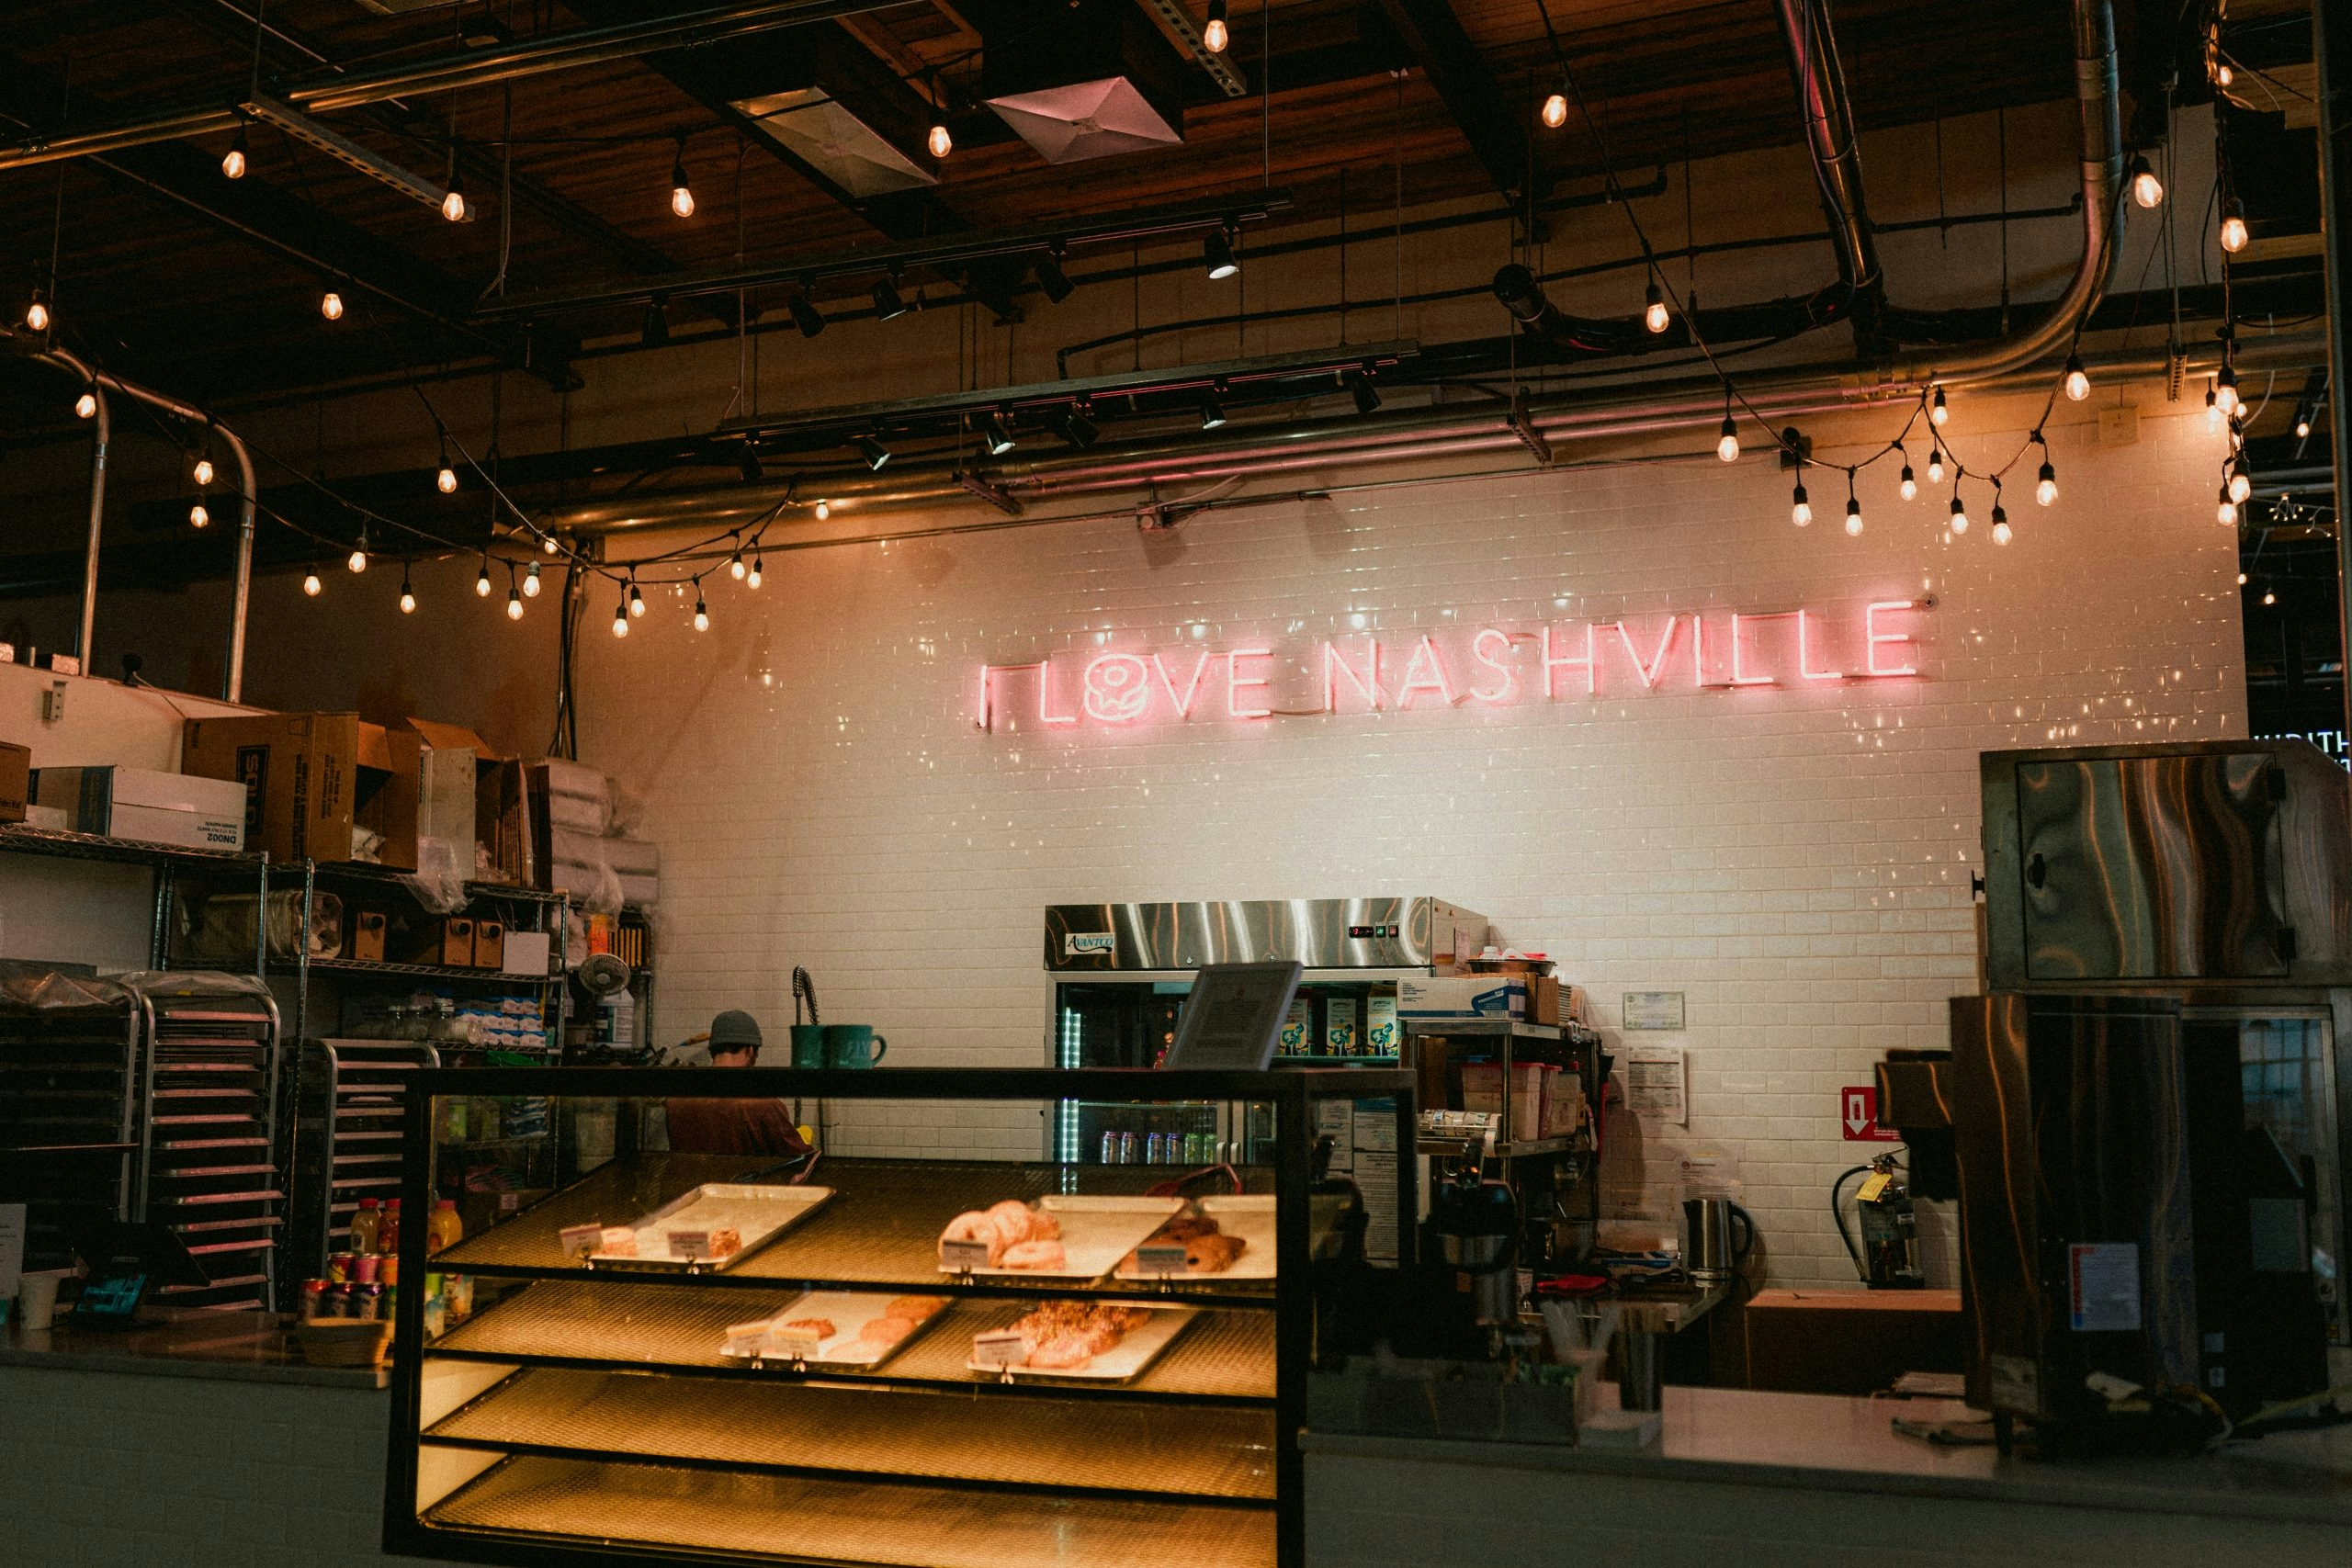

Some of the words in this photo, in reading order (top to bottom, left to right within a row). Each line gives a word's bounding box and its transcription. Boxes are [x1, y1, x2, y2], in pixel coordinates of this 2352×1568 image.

[977, 664, 988, 728] I
[1040, 648, 1272, 724] LOVE
[1324, 601, 1917, 709] NASHVILLE
[207, 832, 237, 843] DN002
[1067, 934, 1114, 952] AVANTCO
